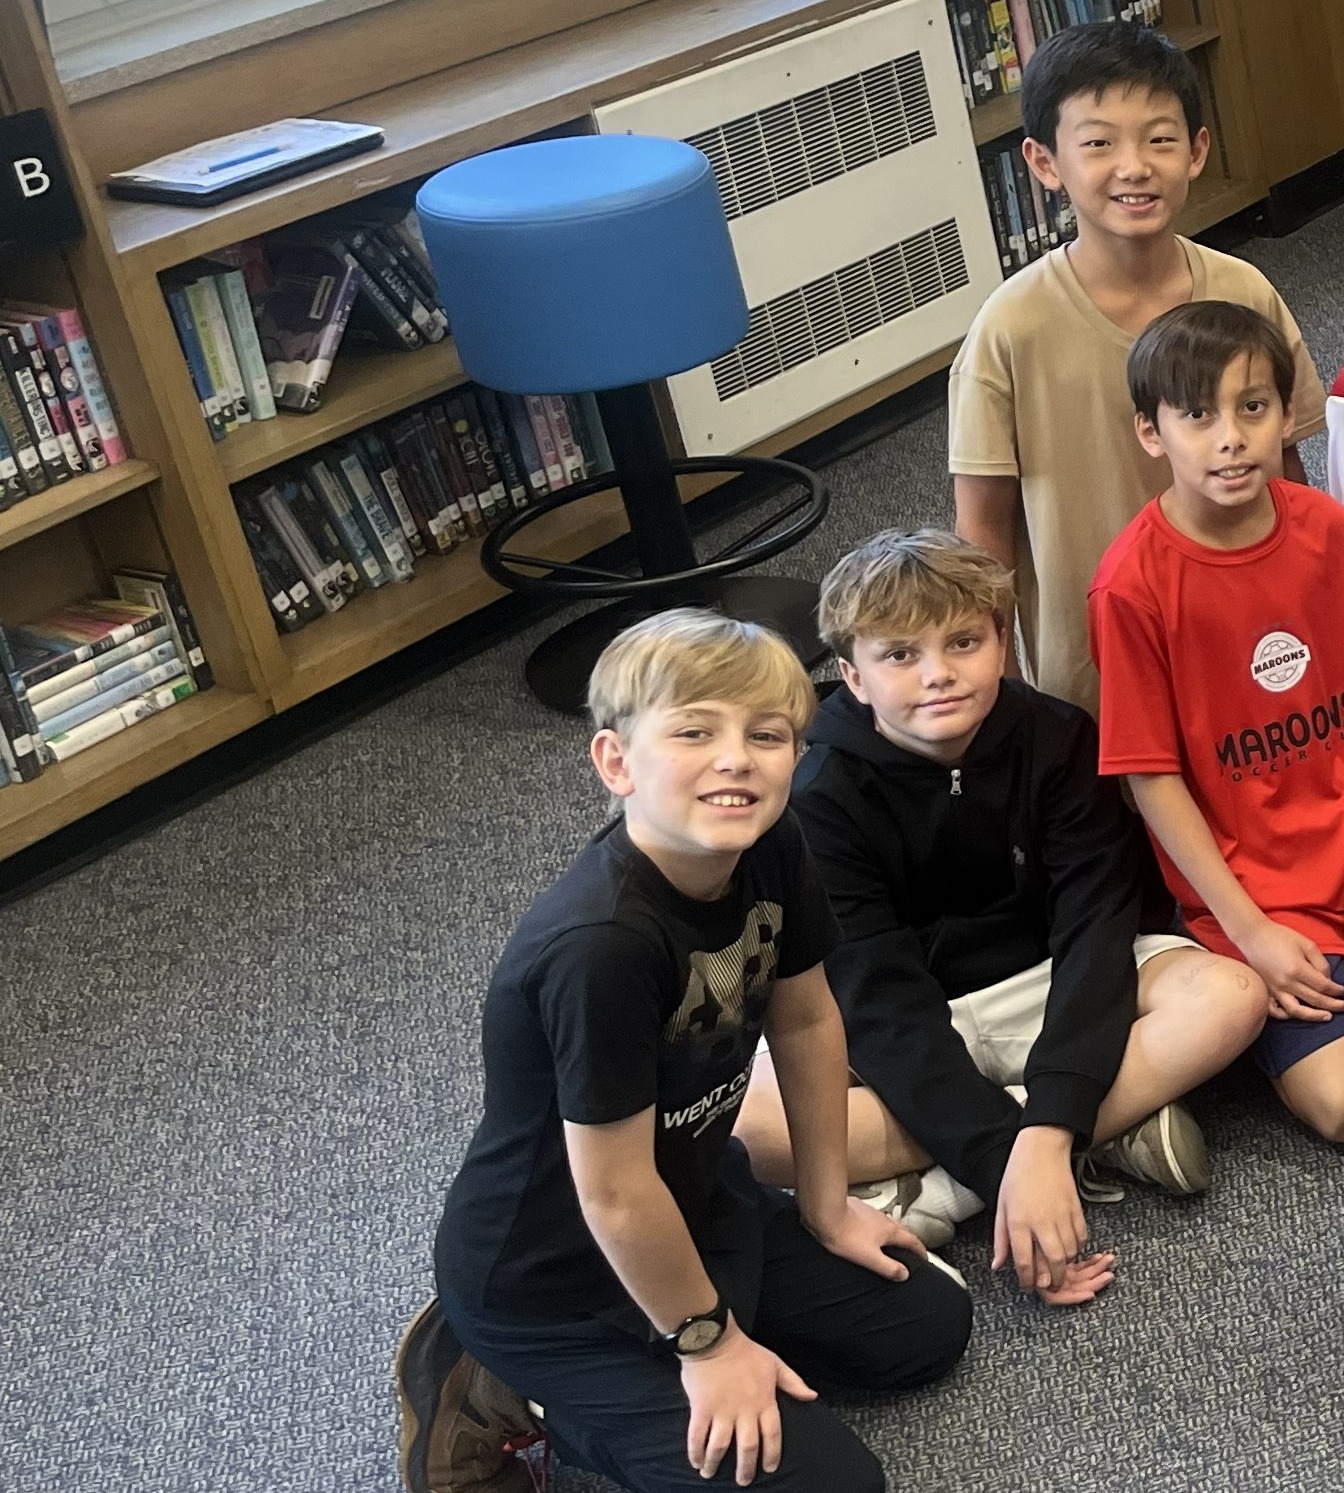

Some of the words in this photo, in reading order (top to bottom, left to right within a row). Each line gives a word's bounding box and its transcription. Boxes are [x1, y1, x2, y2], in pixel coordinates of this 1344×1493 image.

[13, 156, 51, 199] B
[1254, 649, 1306, 675] MAROONS
[1232, 752, 1308, 782] OCCER
[663, 1083, 727, 1130] WENT
